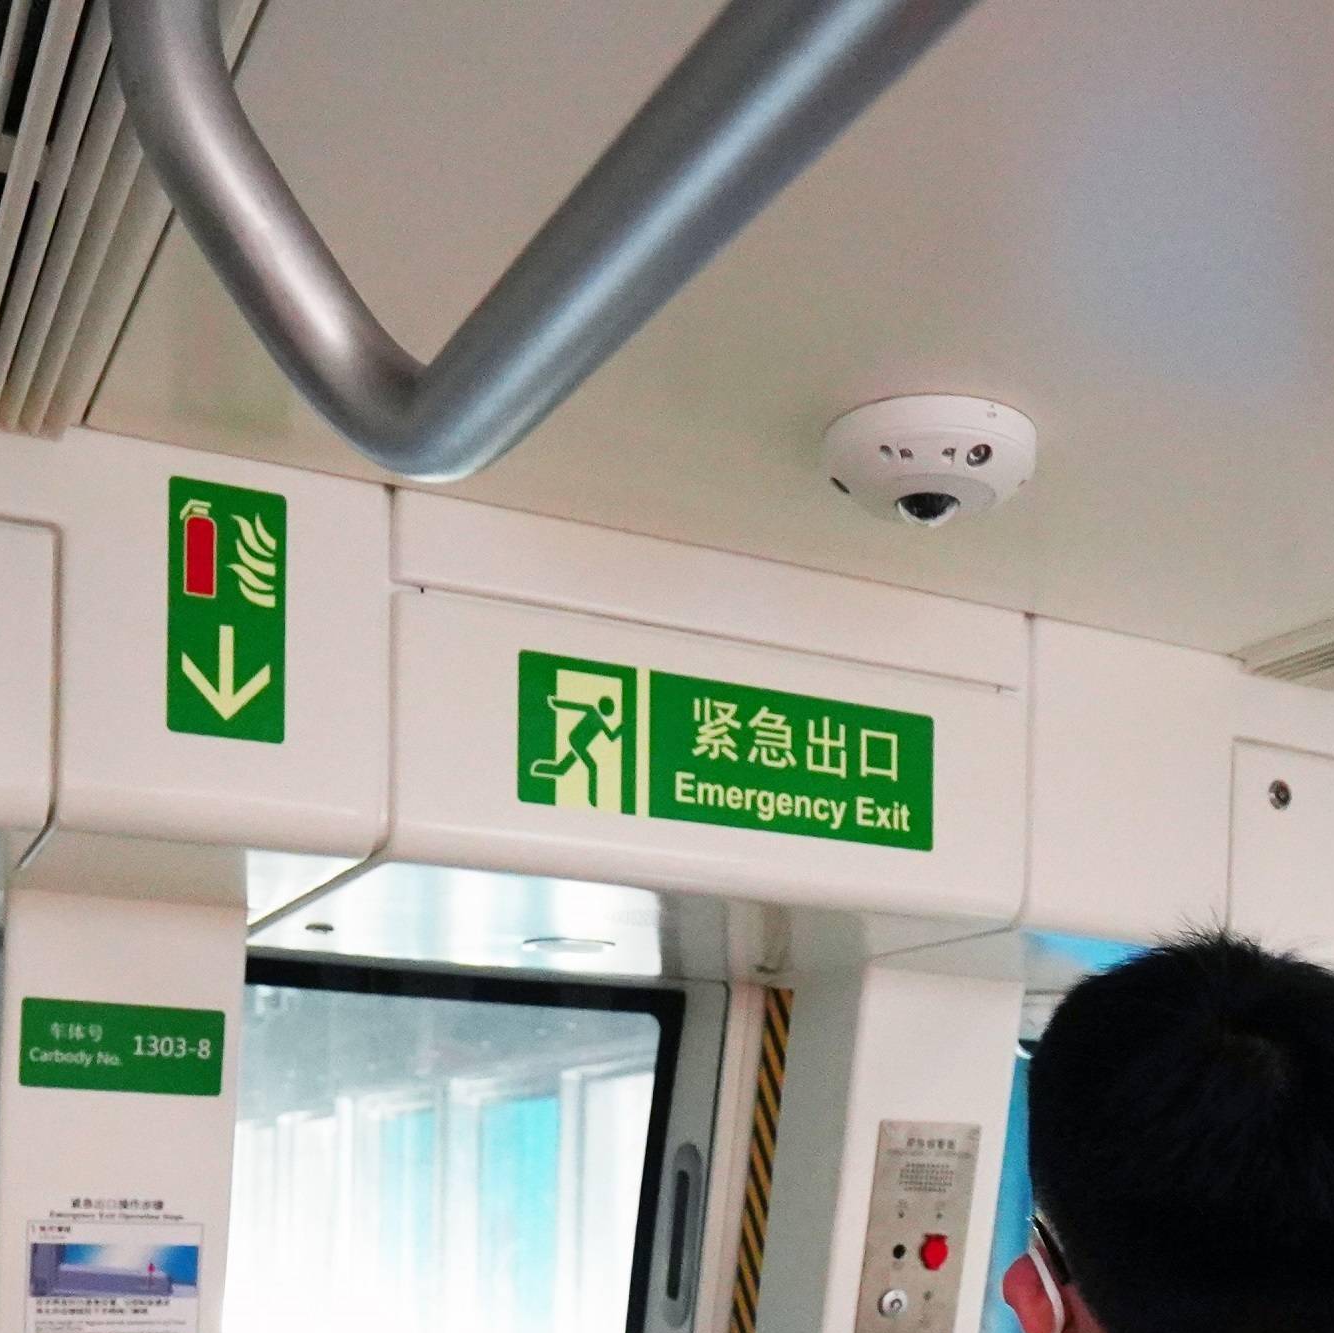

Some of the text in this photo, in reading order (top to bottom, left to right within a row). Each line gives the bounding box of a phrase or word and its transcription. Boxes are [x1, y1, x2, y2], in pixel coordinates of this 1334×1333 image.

[692, 698, 899, 781] 紧急出口
[675, 772, 911, 833] Emergency Exit
[29, 1046, 122, 1068] Carbody No.
[132, 1034, 212, 1060] 1303-8
